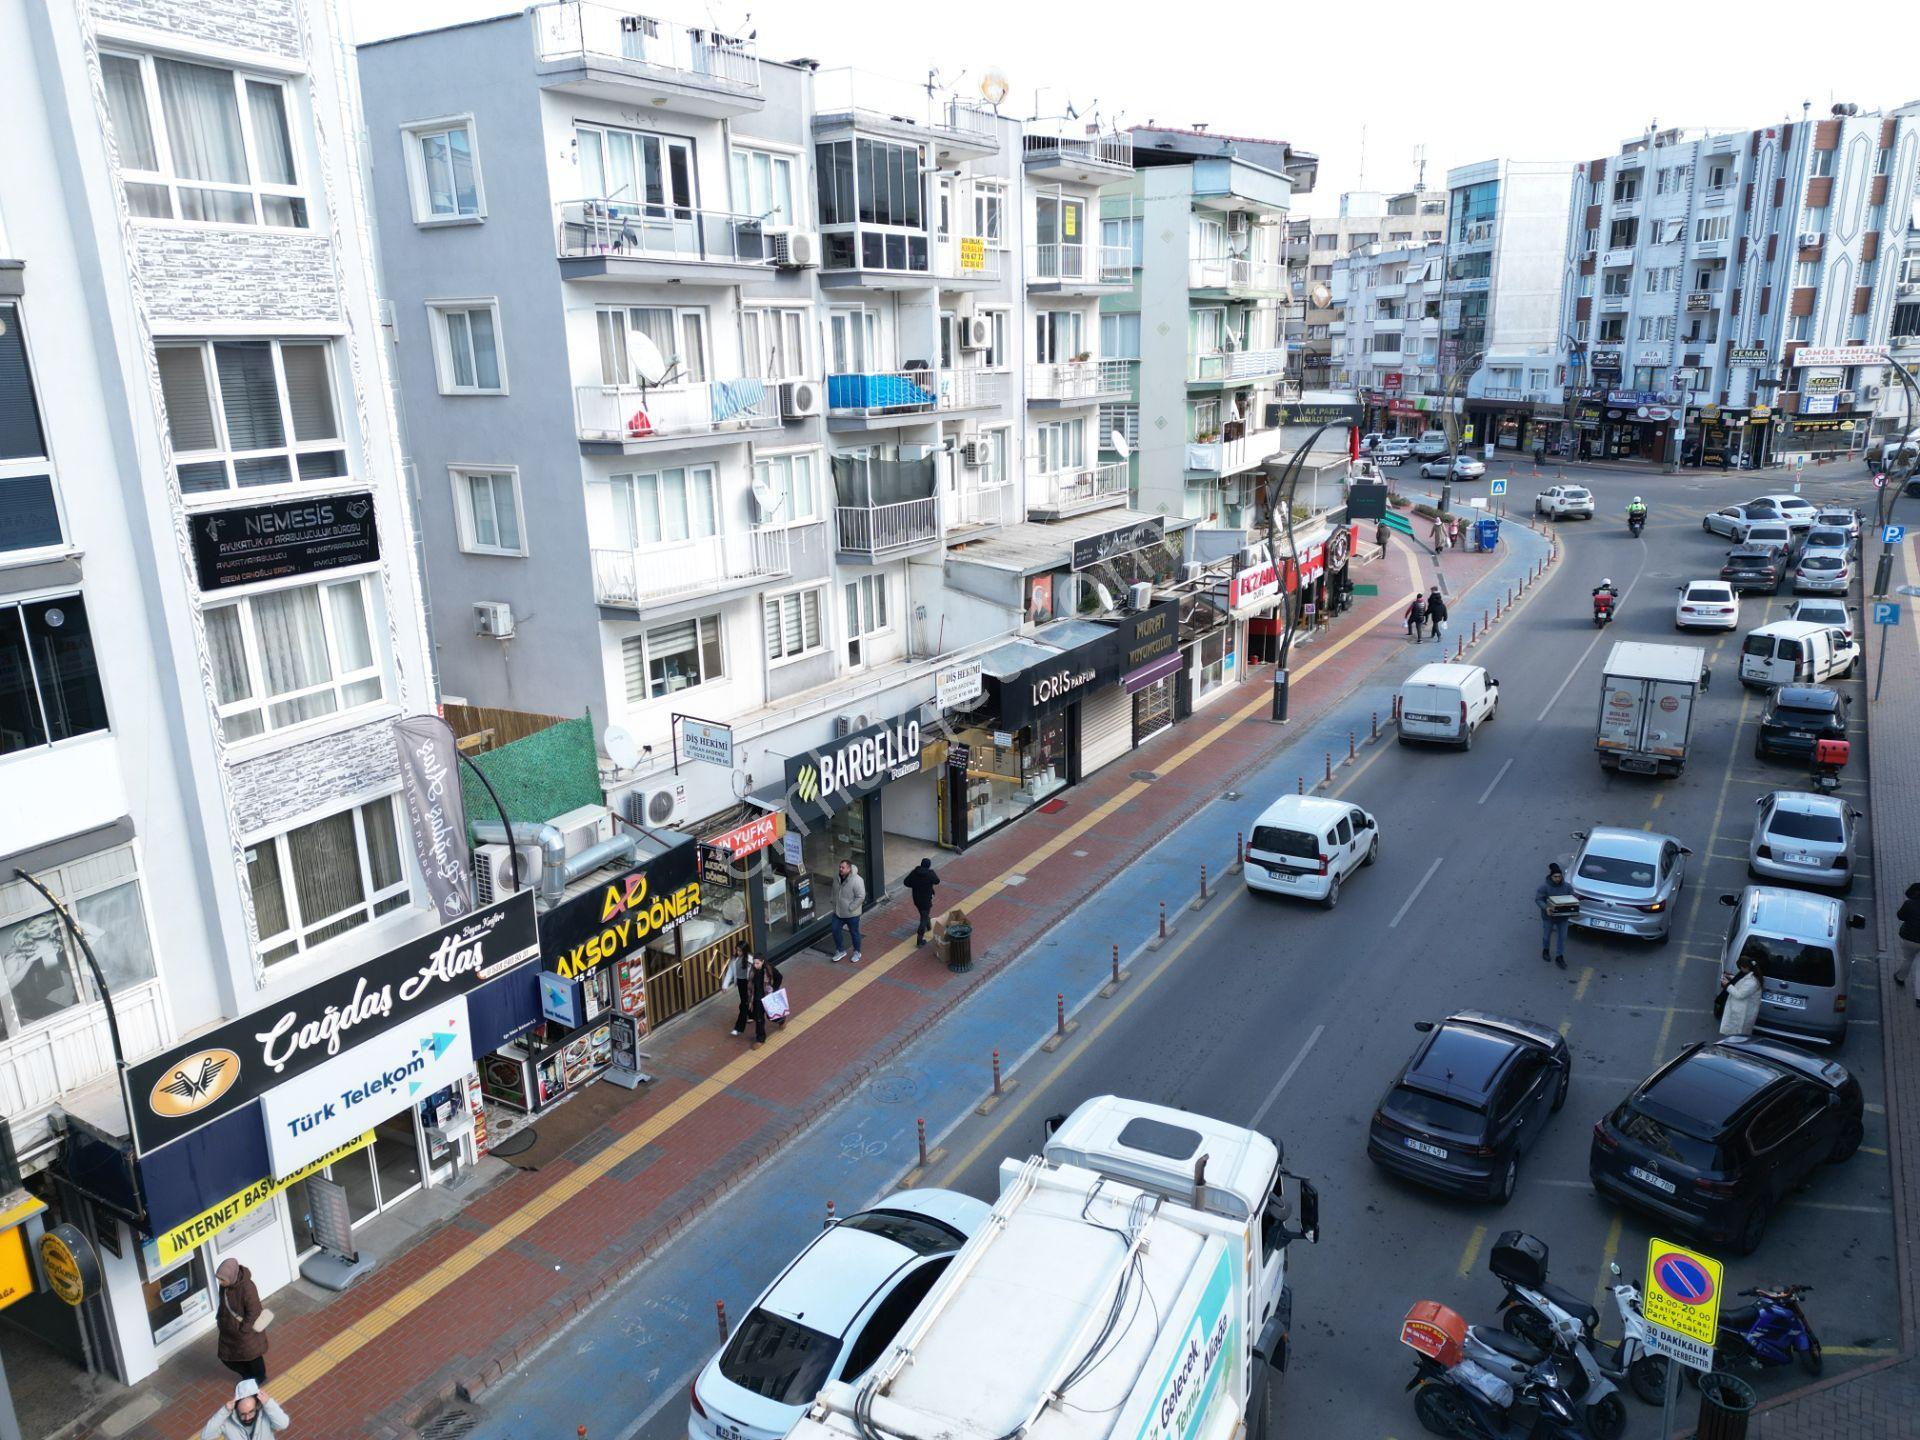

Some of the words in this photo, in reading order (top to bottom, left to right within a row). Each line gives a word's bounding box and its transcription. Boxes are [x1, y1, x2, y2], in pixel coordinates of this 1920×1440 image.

[1318, 407, 1344, 415] PARTİ
[245, 503, 335, 535] NEMESİS
[1136, 612, 1167, 640] MURAT
[1876, 605, 1891, 622] P
[1032, 669, 1071, 707] LORIS
[1071, 668, 1097, 689] PARFUM
[686, 734, 698, 746] DİŞ
[700, 736, 729, 750] HEKİMİ
[820, 720, 920, 797] BARGELLO
[734, 819, 774, 847] YUFKA
[734, 835, 769, 858] DAYIF
[704, 860, 728, 874] AKSOY
[556, 918, 631, 980] AKSOY
[636, 882, 702, 939] DÖNER
[574, 974, 584, 983] 75
[586, 966, 596, 977] 47
[255, 976, 392, 1073] Çağdaş
[399, 930, 484, 1001] Ataş
[287, 1102, 337, 1138] Türk
[340, 1056, 425, 1109] Telekom
[1410, 1140, 1416, 1149] 35
[1419, 1142, 1431, 1152] BNZ
[1432, 1148, 1446, 1158] 491
[1636, 1168, 1642, 1177] 35
[1660, 1180, 1674, 1192] 700
[170, 1199, 240, 1252] İNTERNET
[1646, 1308, 1667, 1322] Park
[1670, 1318, 1710, 1338] Yasaktır
[1648, 1300, 1684, 1320] Saatleri
[1686, 1314, 1710, 1329] Arası
[1646, 1325, 1658, 1336] 30
[1660, 1330, 1710, 1357] DAKİKALIK
[1658, 1342, 1672, 1354] PARK
[1162, 1340, 1199, 1430] Gelecek
[1176, 1375, 1201, 1440] Temiz
[1204, 1314, 1228, 1382] Aliağa
